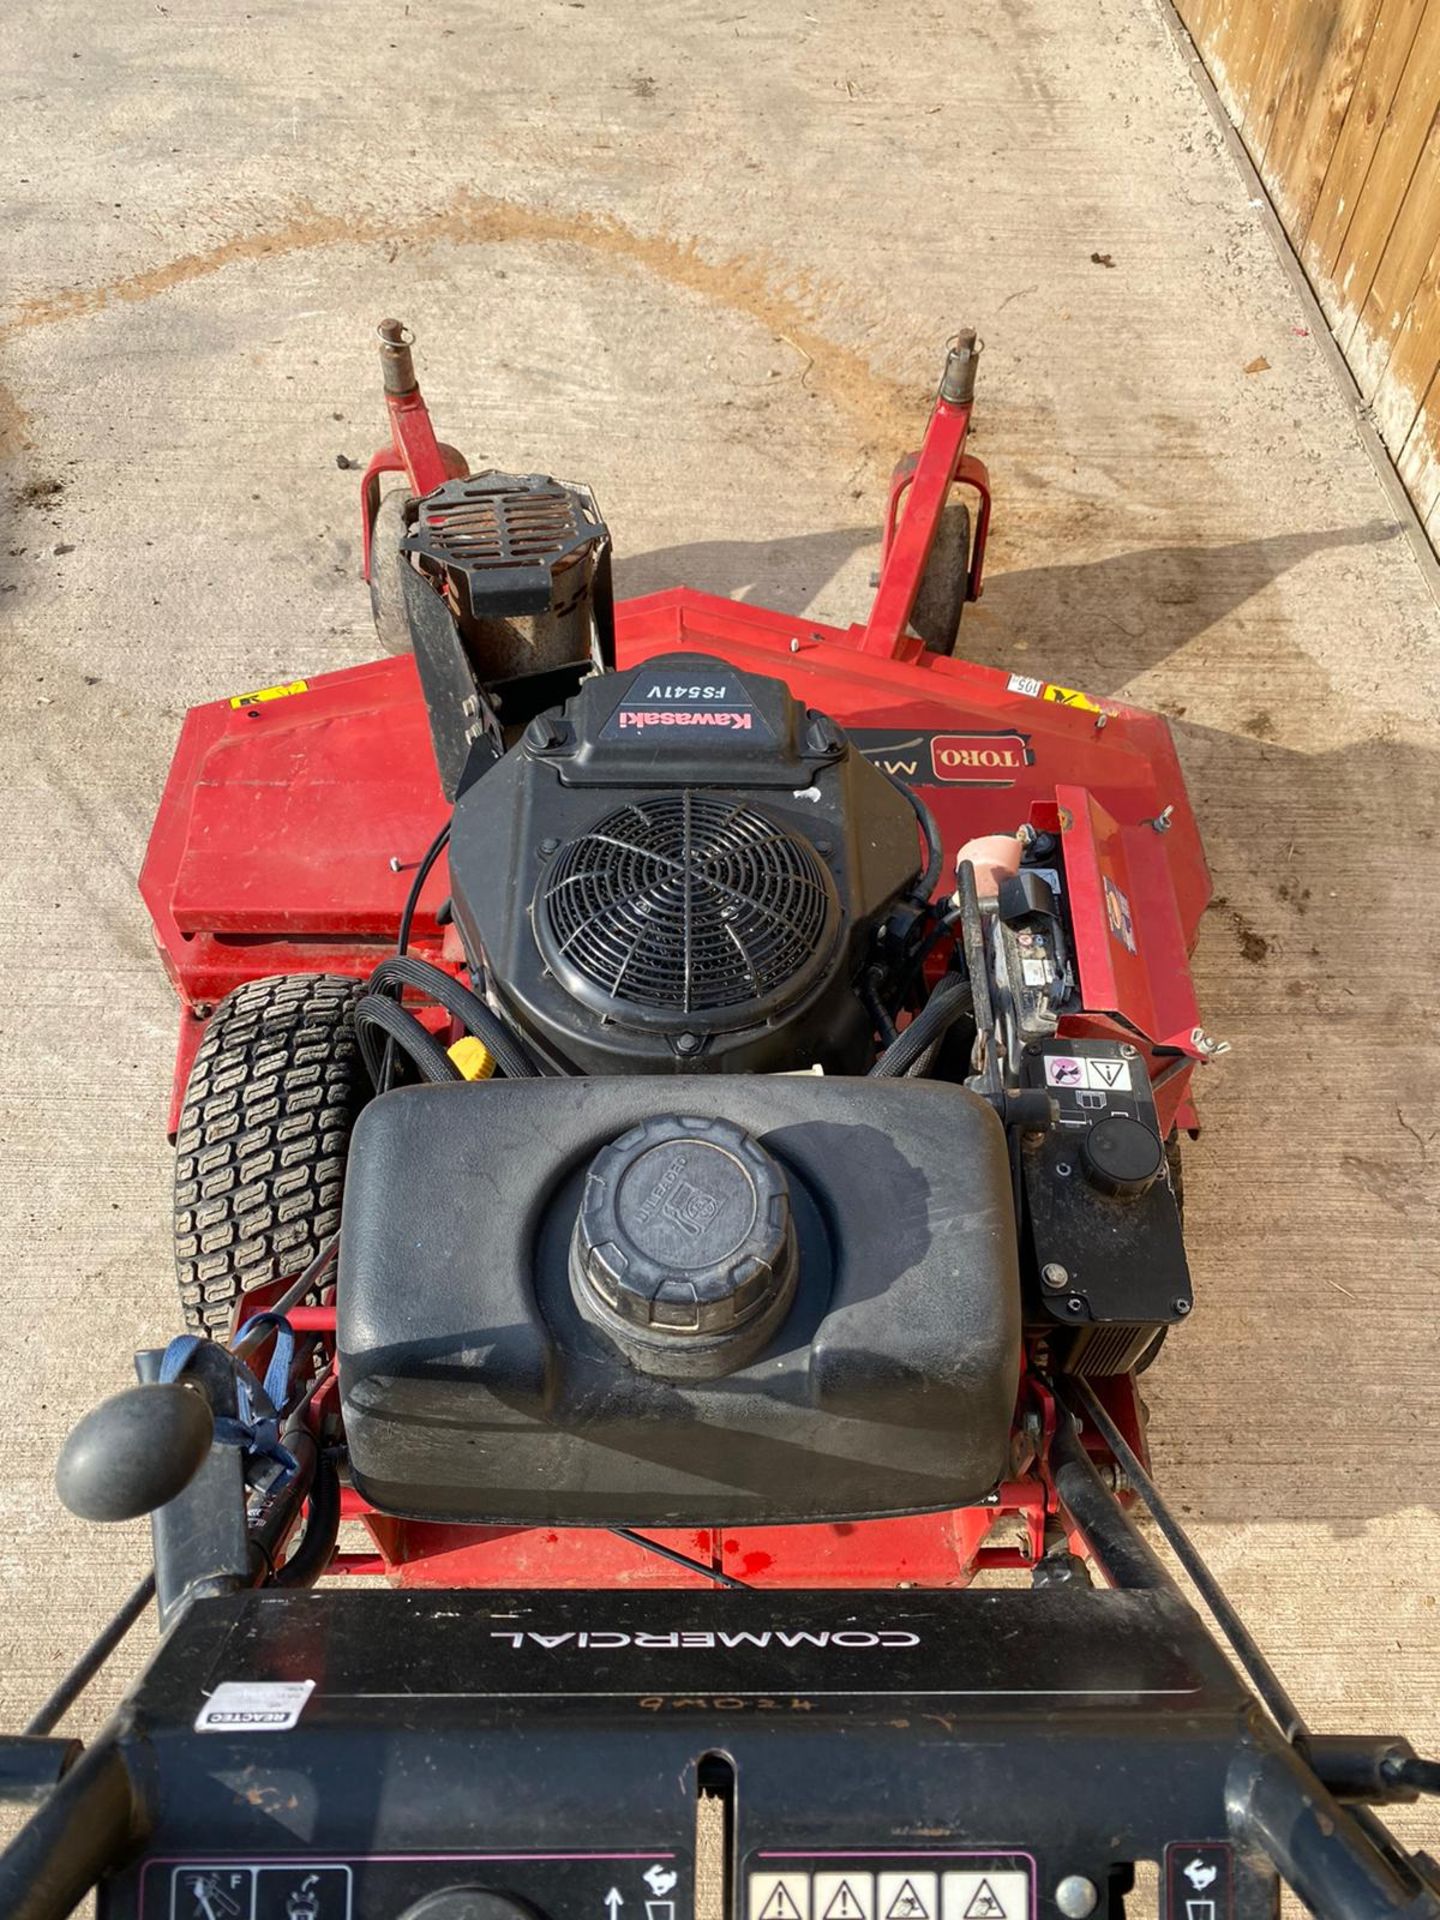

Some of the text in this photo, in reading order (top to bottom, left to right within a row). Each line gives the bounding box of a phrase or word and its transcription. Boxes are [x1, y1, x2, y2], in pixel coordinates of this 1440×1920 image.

[647, 686, 726, 699] FS541V
[1018, 678, 1038, 694] 105
[619, 712, 752, 729] Kawasaki
[941, 749, 1020, 768] TORO
[634, 1153, 688, 1224] UNLEADED
[490, 1631, 920, 1648] COMMERCIAL
[209, 1713, 286, 1722] REACTEC
[231, 1873, 242, 1889] F
